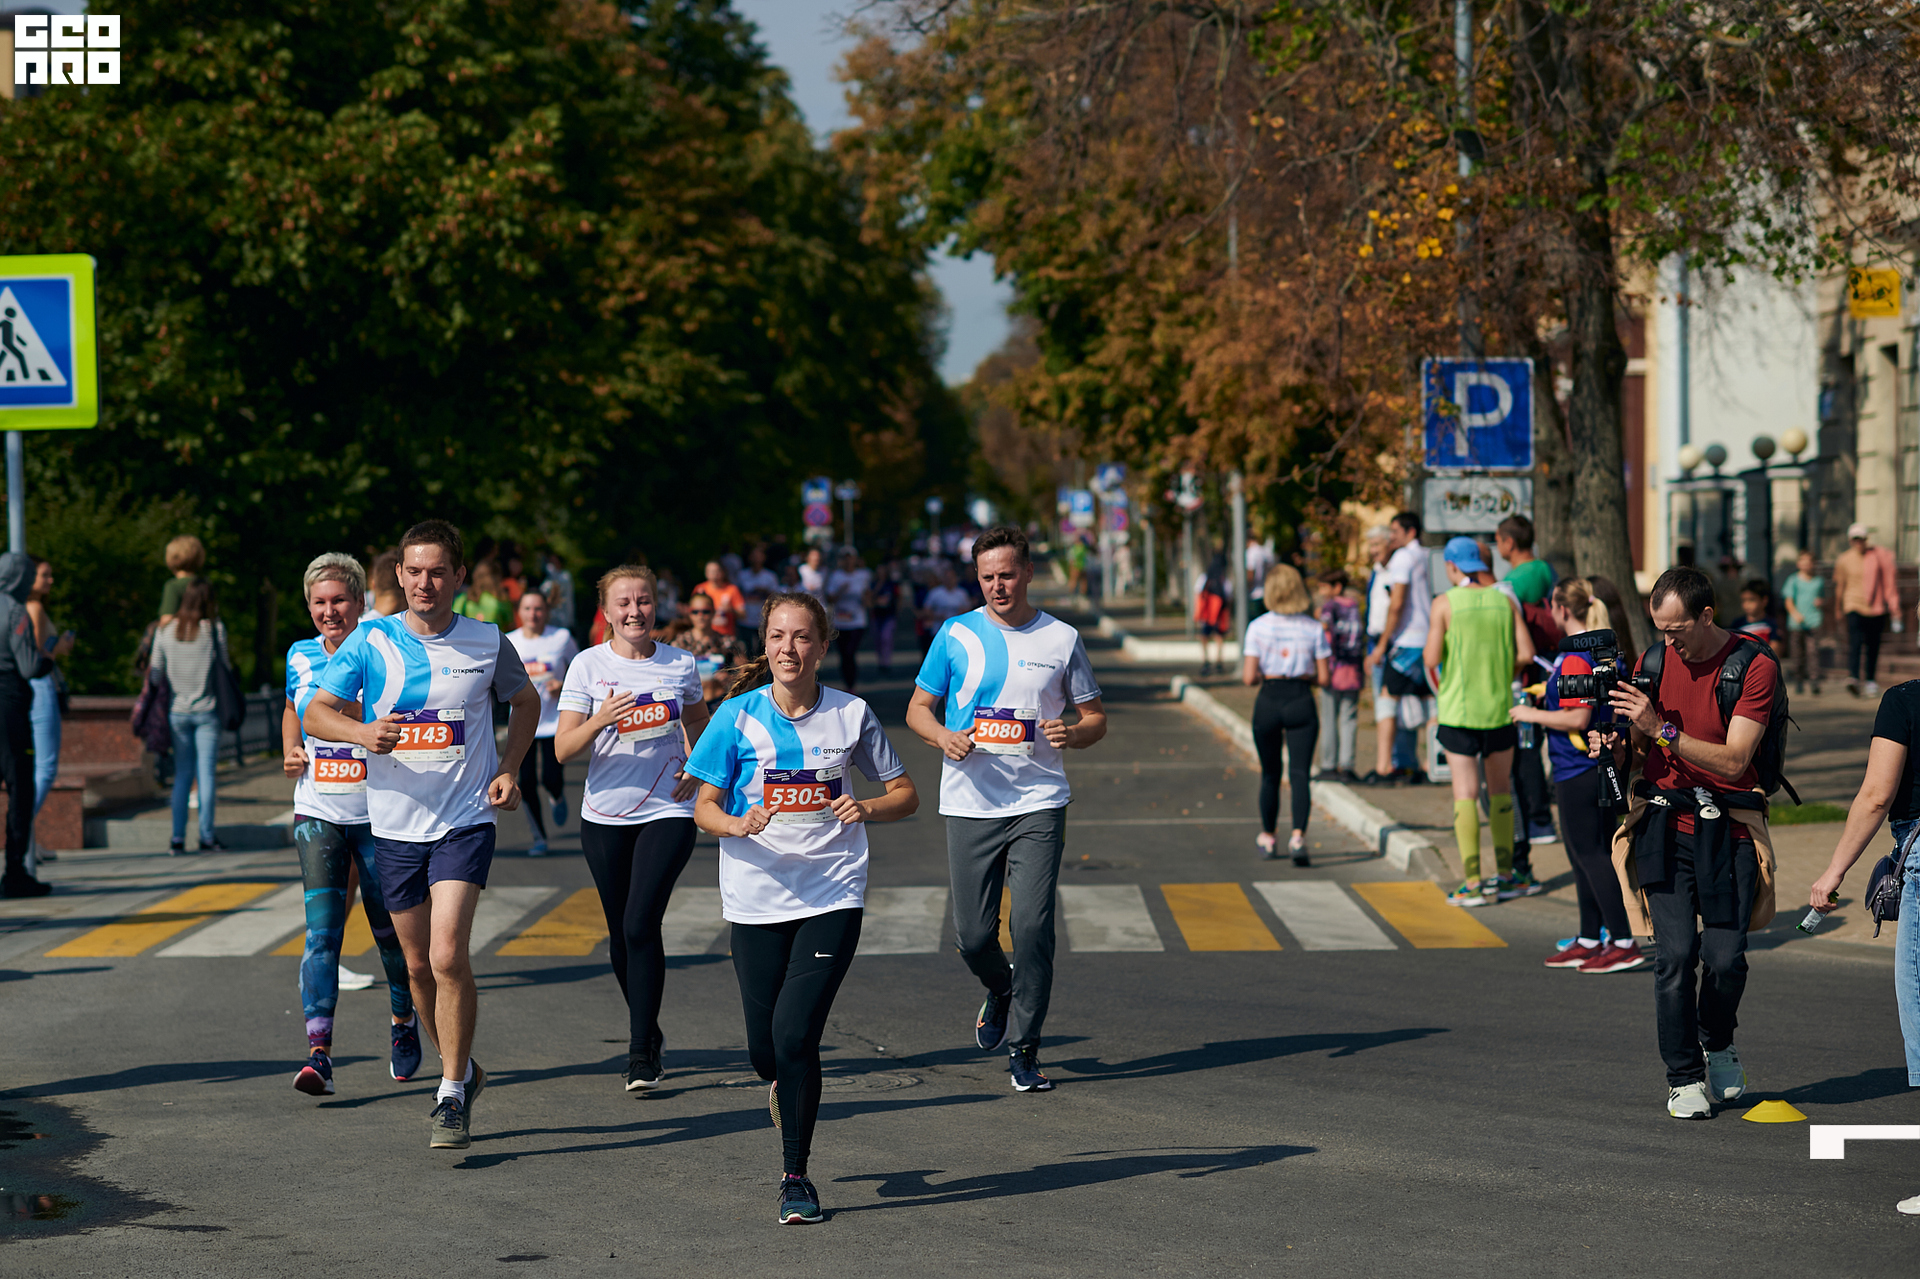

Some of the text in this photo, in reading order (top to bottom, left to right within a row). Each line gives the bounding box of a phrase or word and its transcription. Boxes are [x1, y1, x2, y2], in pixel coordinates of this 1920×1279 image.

[1454, 371, 1514, 457] P
[1572, 635, 1605, 649] RØDE
[399, 726, 448, 744] 5143
[977, 721, 1023, 739] 5080
[318, 761, 362, 778] 5390
[769, 786, 827, 806] 5305
